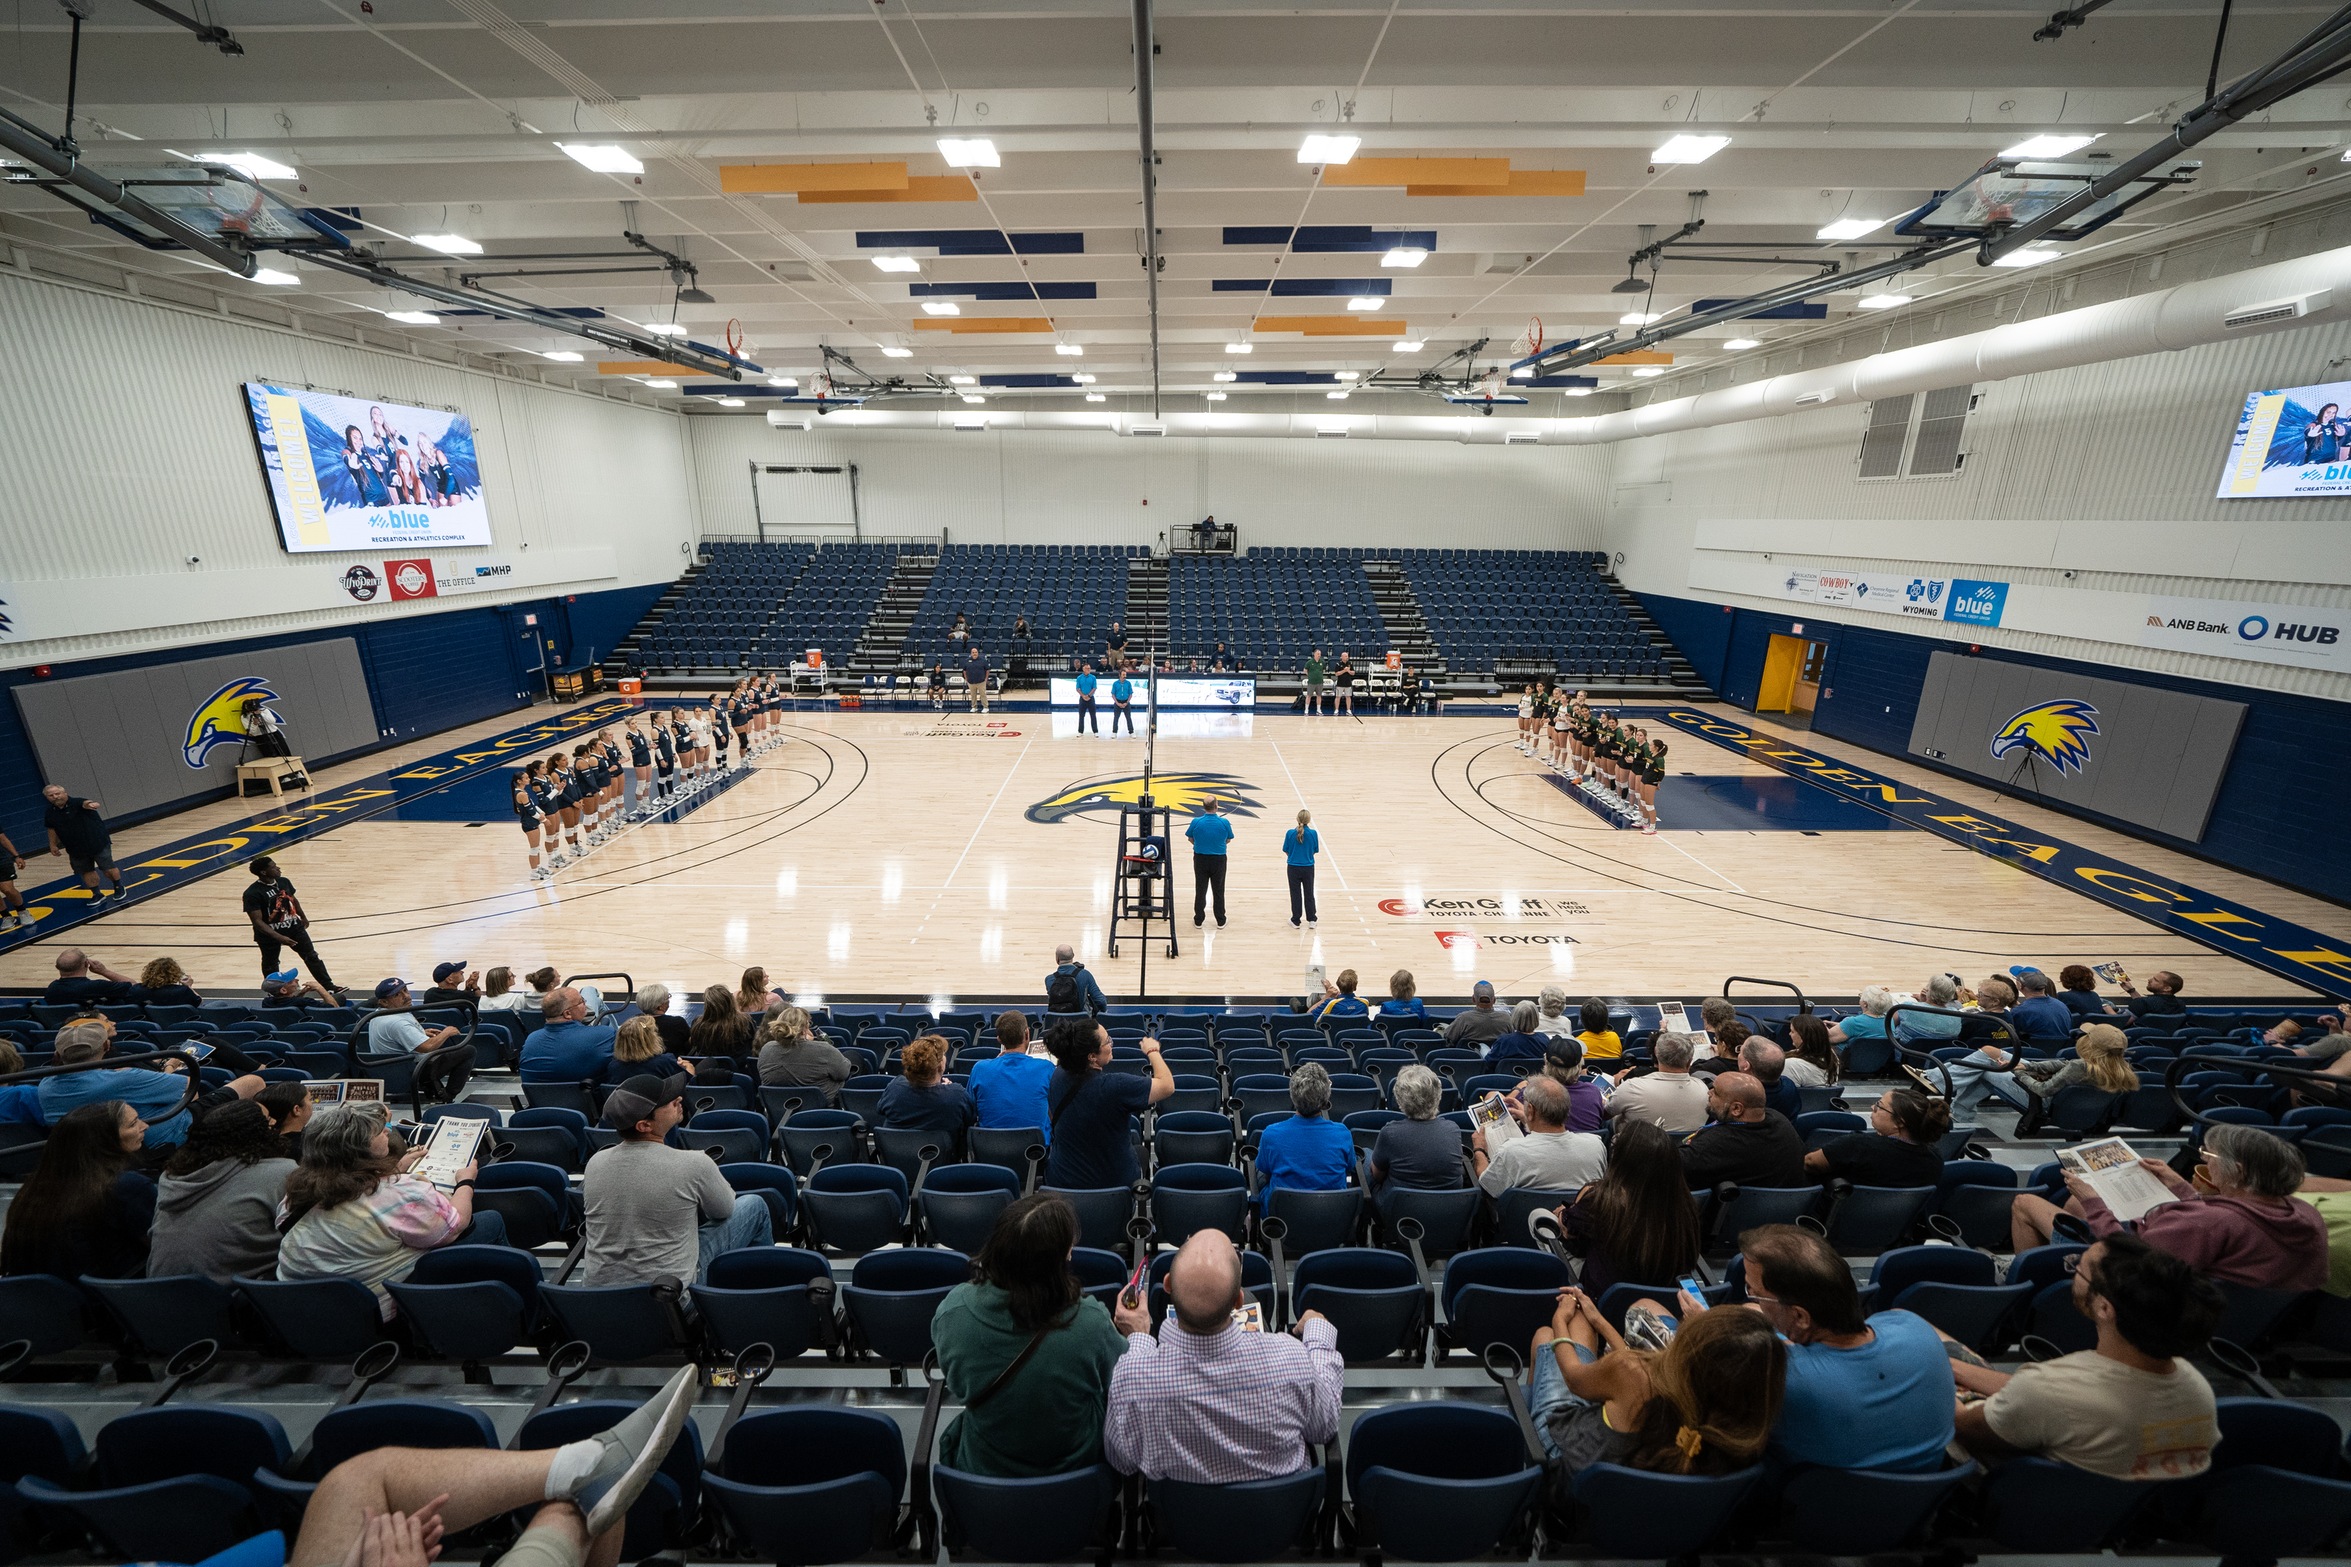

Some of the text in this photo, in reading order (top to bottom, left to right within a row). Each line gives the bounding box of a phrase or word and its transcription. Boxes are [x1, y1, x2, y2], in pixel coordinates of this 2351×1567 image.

[2240, 409, 2276, 480] WELCOME!
[278, 417, 321, 526] WELCOME!
[388, 510, 430, 528] blue
[491, 565, 511, 576] MHP
[437, 577, 476, 587] THE OFFICE
[1820, 576, 1849, 589] COWBOY
[1903, 605, 1938, 616] WYOMING
[1955, 596, 1993, 615] blue
[2167, 618, 2196, 630] ANB
[2274, 622, 2340, 644] HUB
[623, 684, 631, 692] G
[1668, 712, 1937, 805] GOLDEN
[0, 704, 635, 935] LDEN EAGLES
[1422, 898, 1544, 910] Ken Gff
[1483, 935, 1582, 945] TOYOTA
